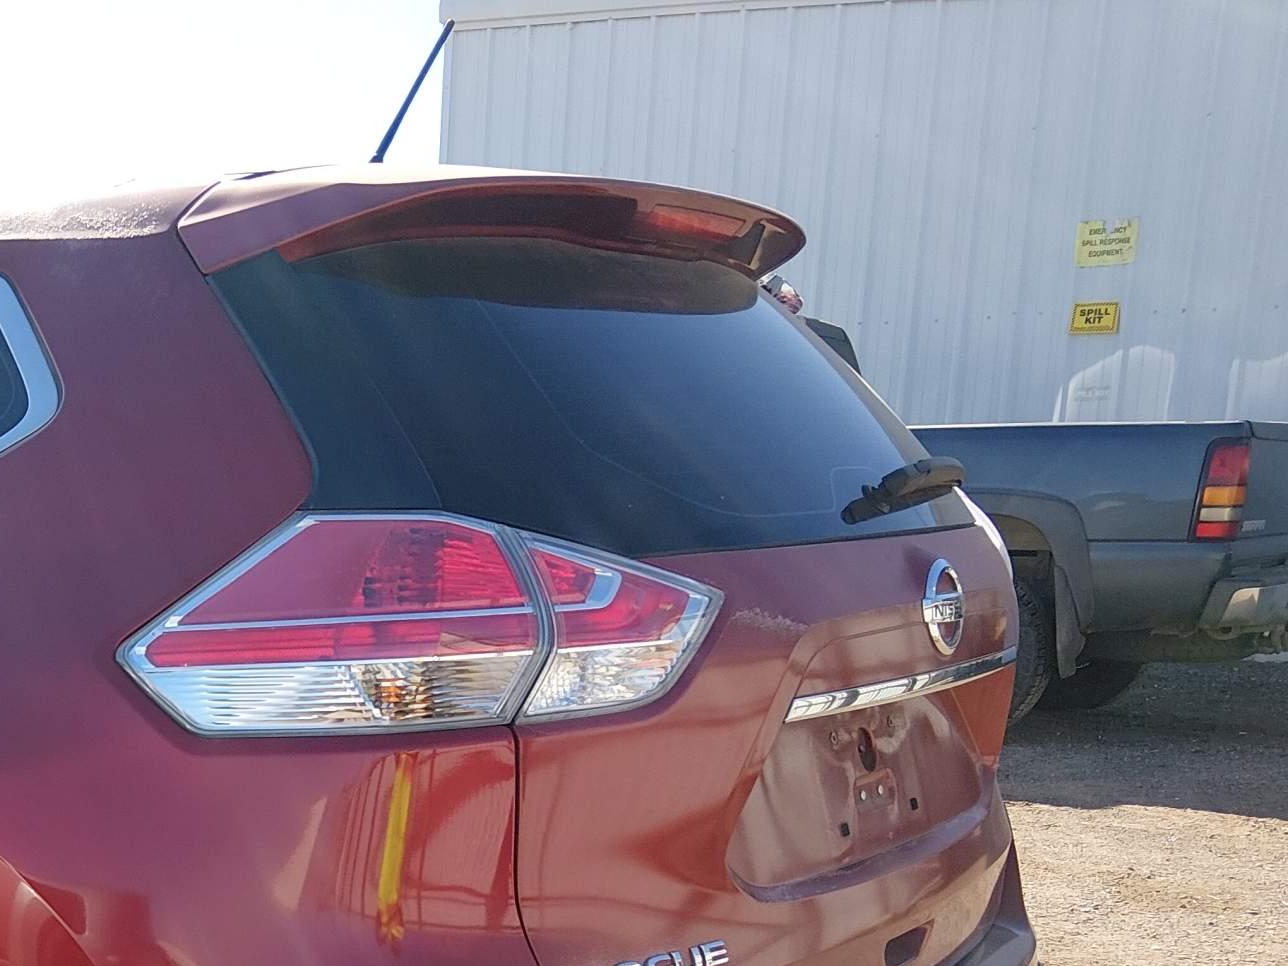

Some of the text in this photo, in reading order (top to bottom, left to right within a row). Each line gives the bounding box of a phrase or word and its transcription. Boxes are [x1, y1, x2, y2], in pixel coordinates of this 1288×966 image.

[1088, 226, 1127, 236] EMERNCY
[1081, 237, 1131, 247] SPILL RESPONSE
[1079, 308, 1111, 317] SPILL
[1084, 316, 1104, 325] KIT
